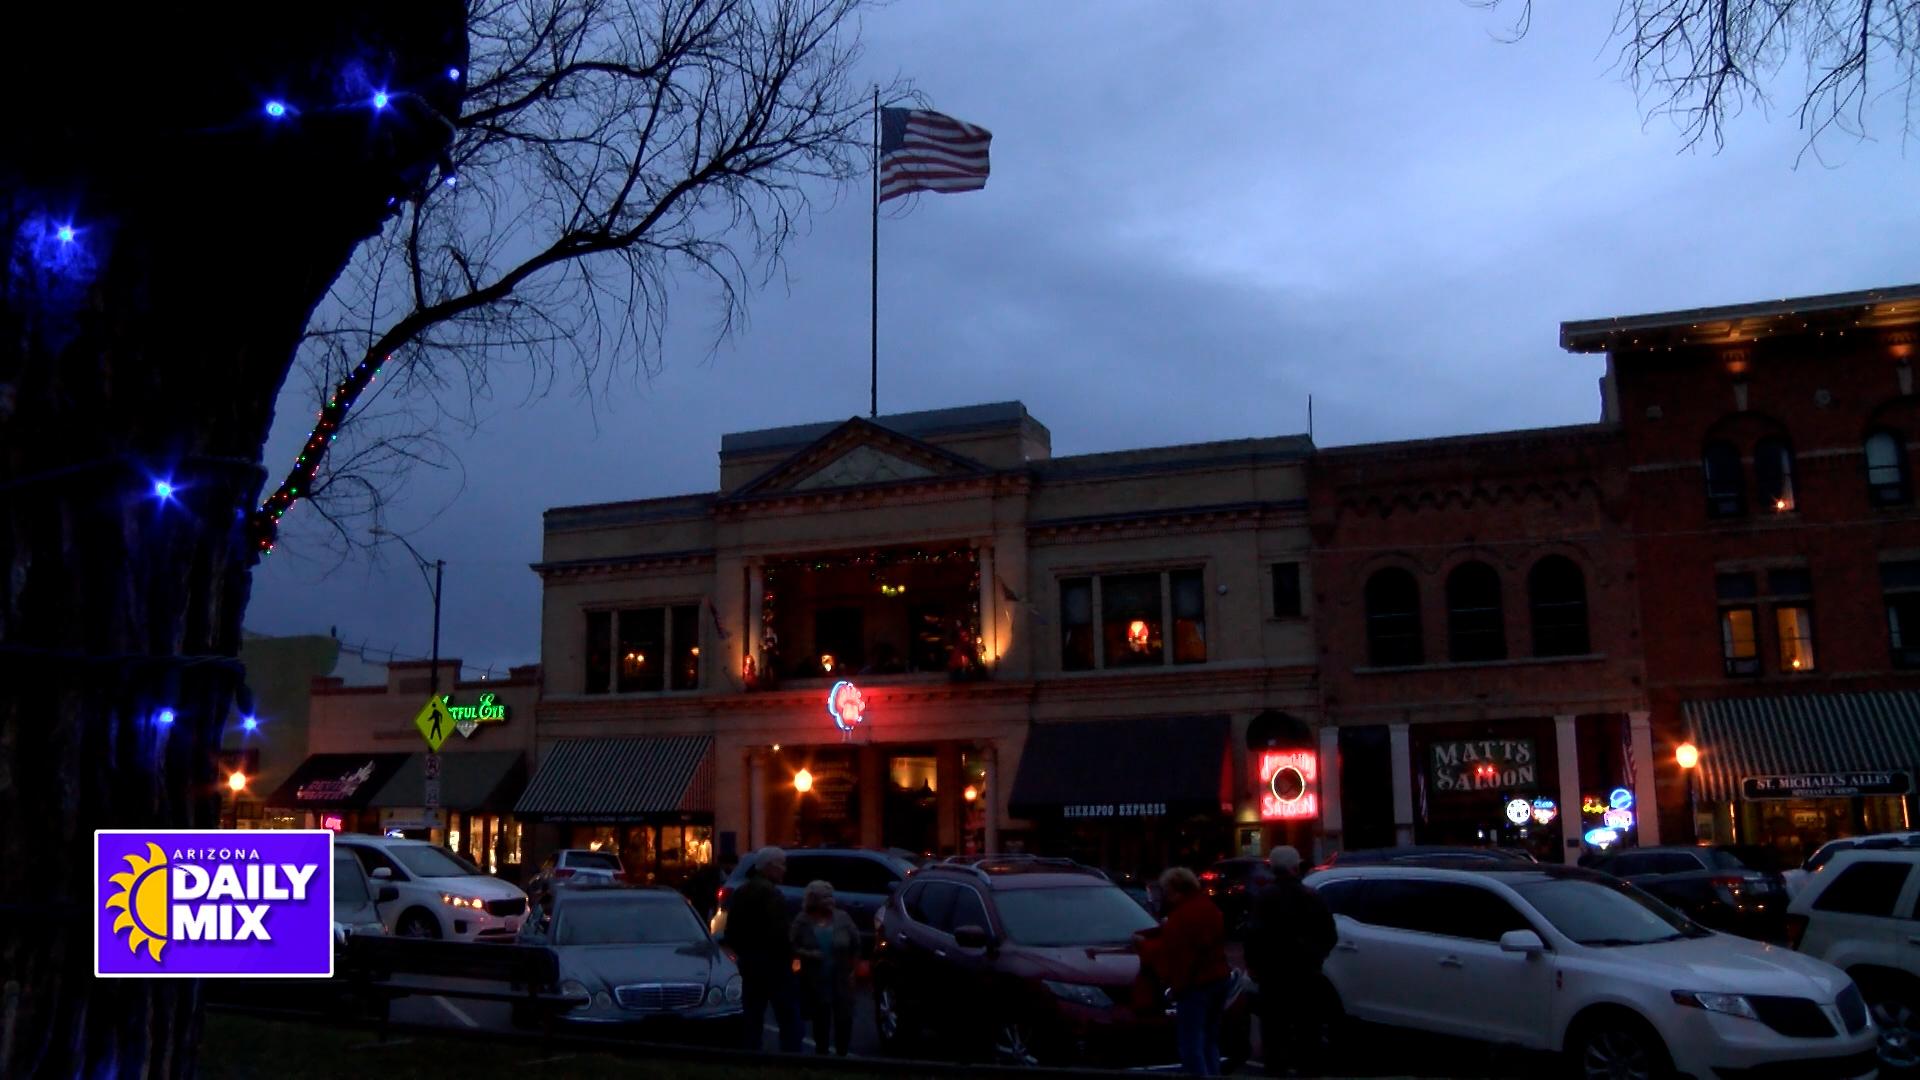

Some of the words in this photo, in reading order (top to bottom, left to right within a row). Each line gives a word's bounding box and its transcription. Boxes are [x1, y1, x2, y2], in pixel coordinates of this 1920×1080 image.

[443, 696, 478, 720] TFUL
[1436, 765, 1535, 791] SALOON
[1851, 773, 1892, 785] ALLEY
[1119, 802, 1167, 817] EXPRESS
